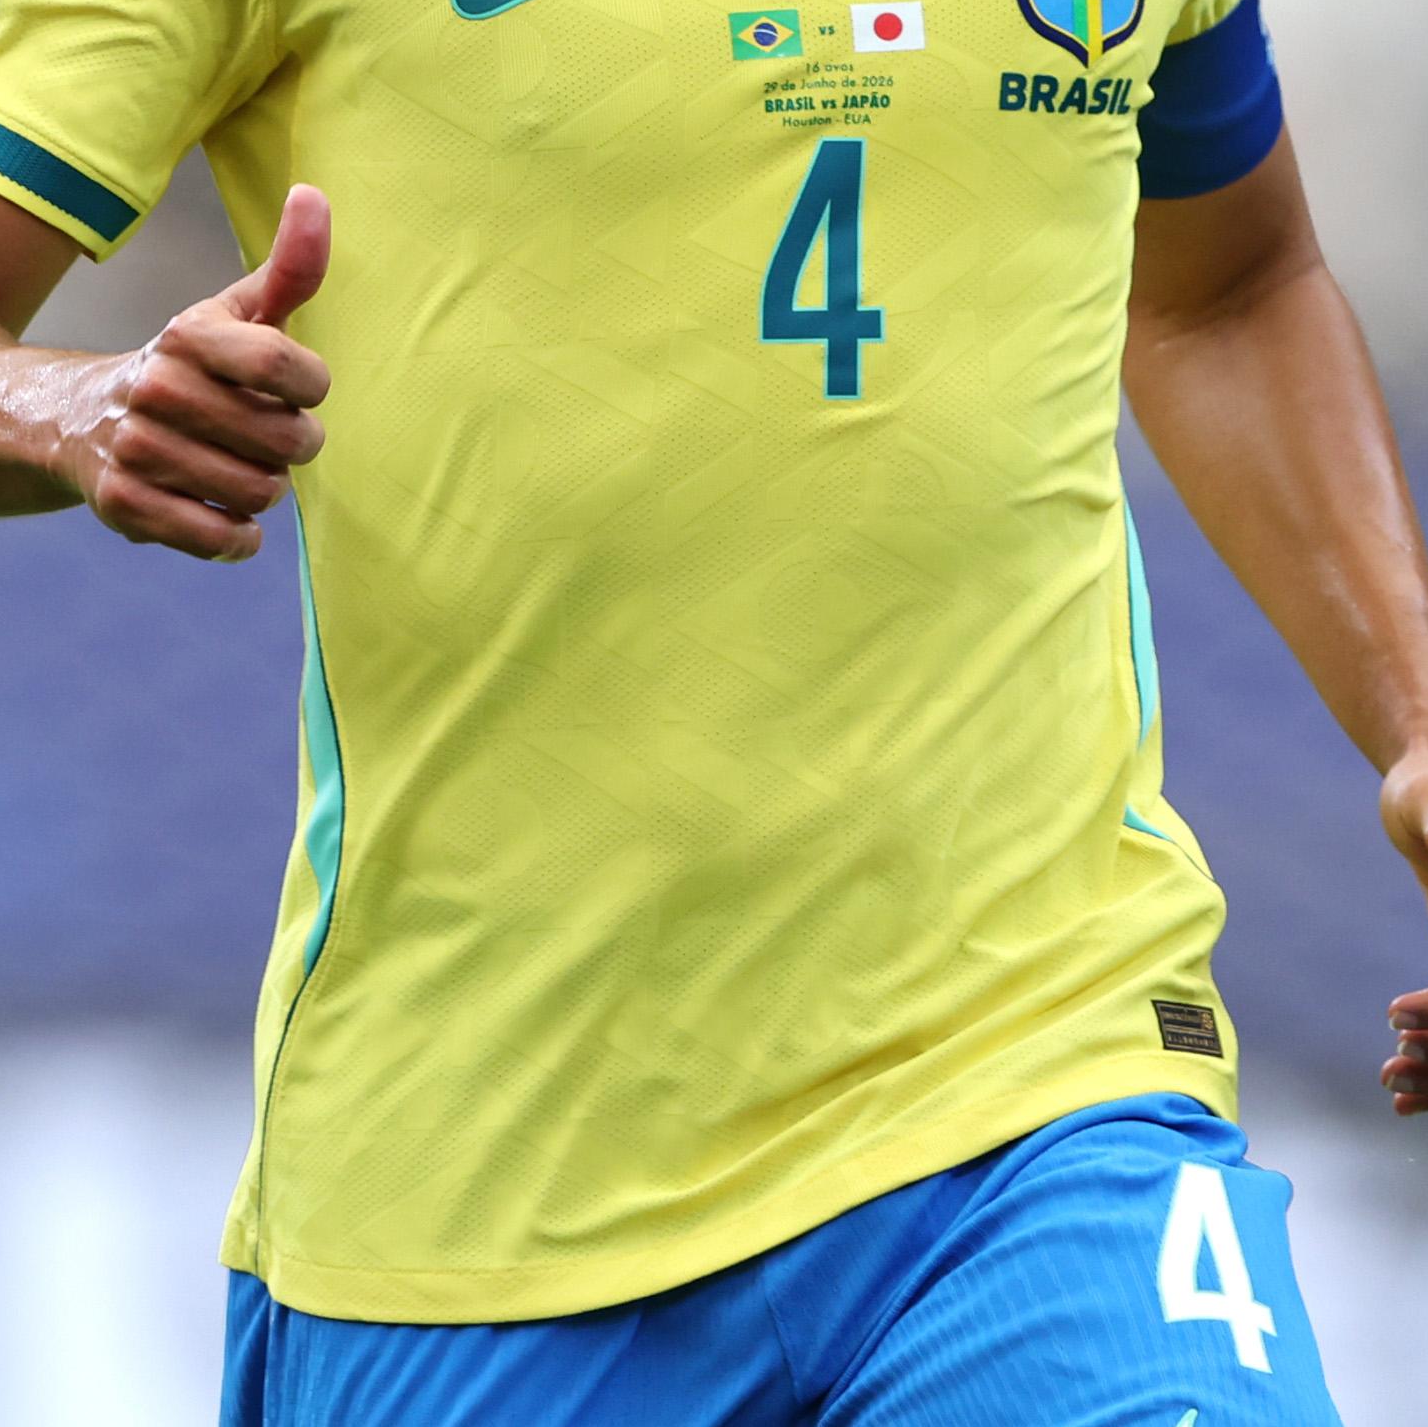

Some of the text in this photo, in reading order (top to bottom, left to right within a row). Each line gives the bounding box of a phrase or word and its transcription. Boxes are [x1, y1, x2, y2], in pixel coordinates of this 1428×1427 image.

[819, 25, 835, 35] vs
[806, 62, 820, 74] 16
[781, 79, 796, 90] de
[841, 76, 857, 88] de
[861, 76, 894, 88] 2026
[822, 99, 837, 110] vs
[842, 91, 890, 108] JAPÃO
[998, 72, 1133, 115] BRASIL
[782, 116, 832, 127] Houston
[844, 114, 872, 125] EUA
[759, 137, 885, 400] 4
[1156, 1160, 1277, 1375] 4
